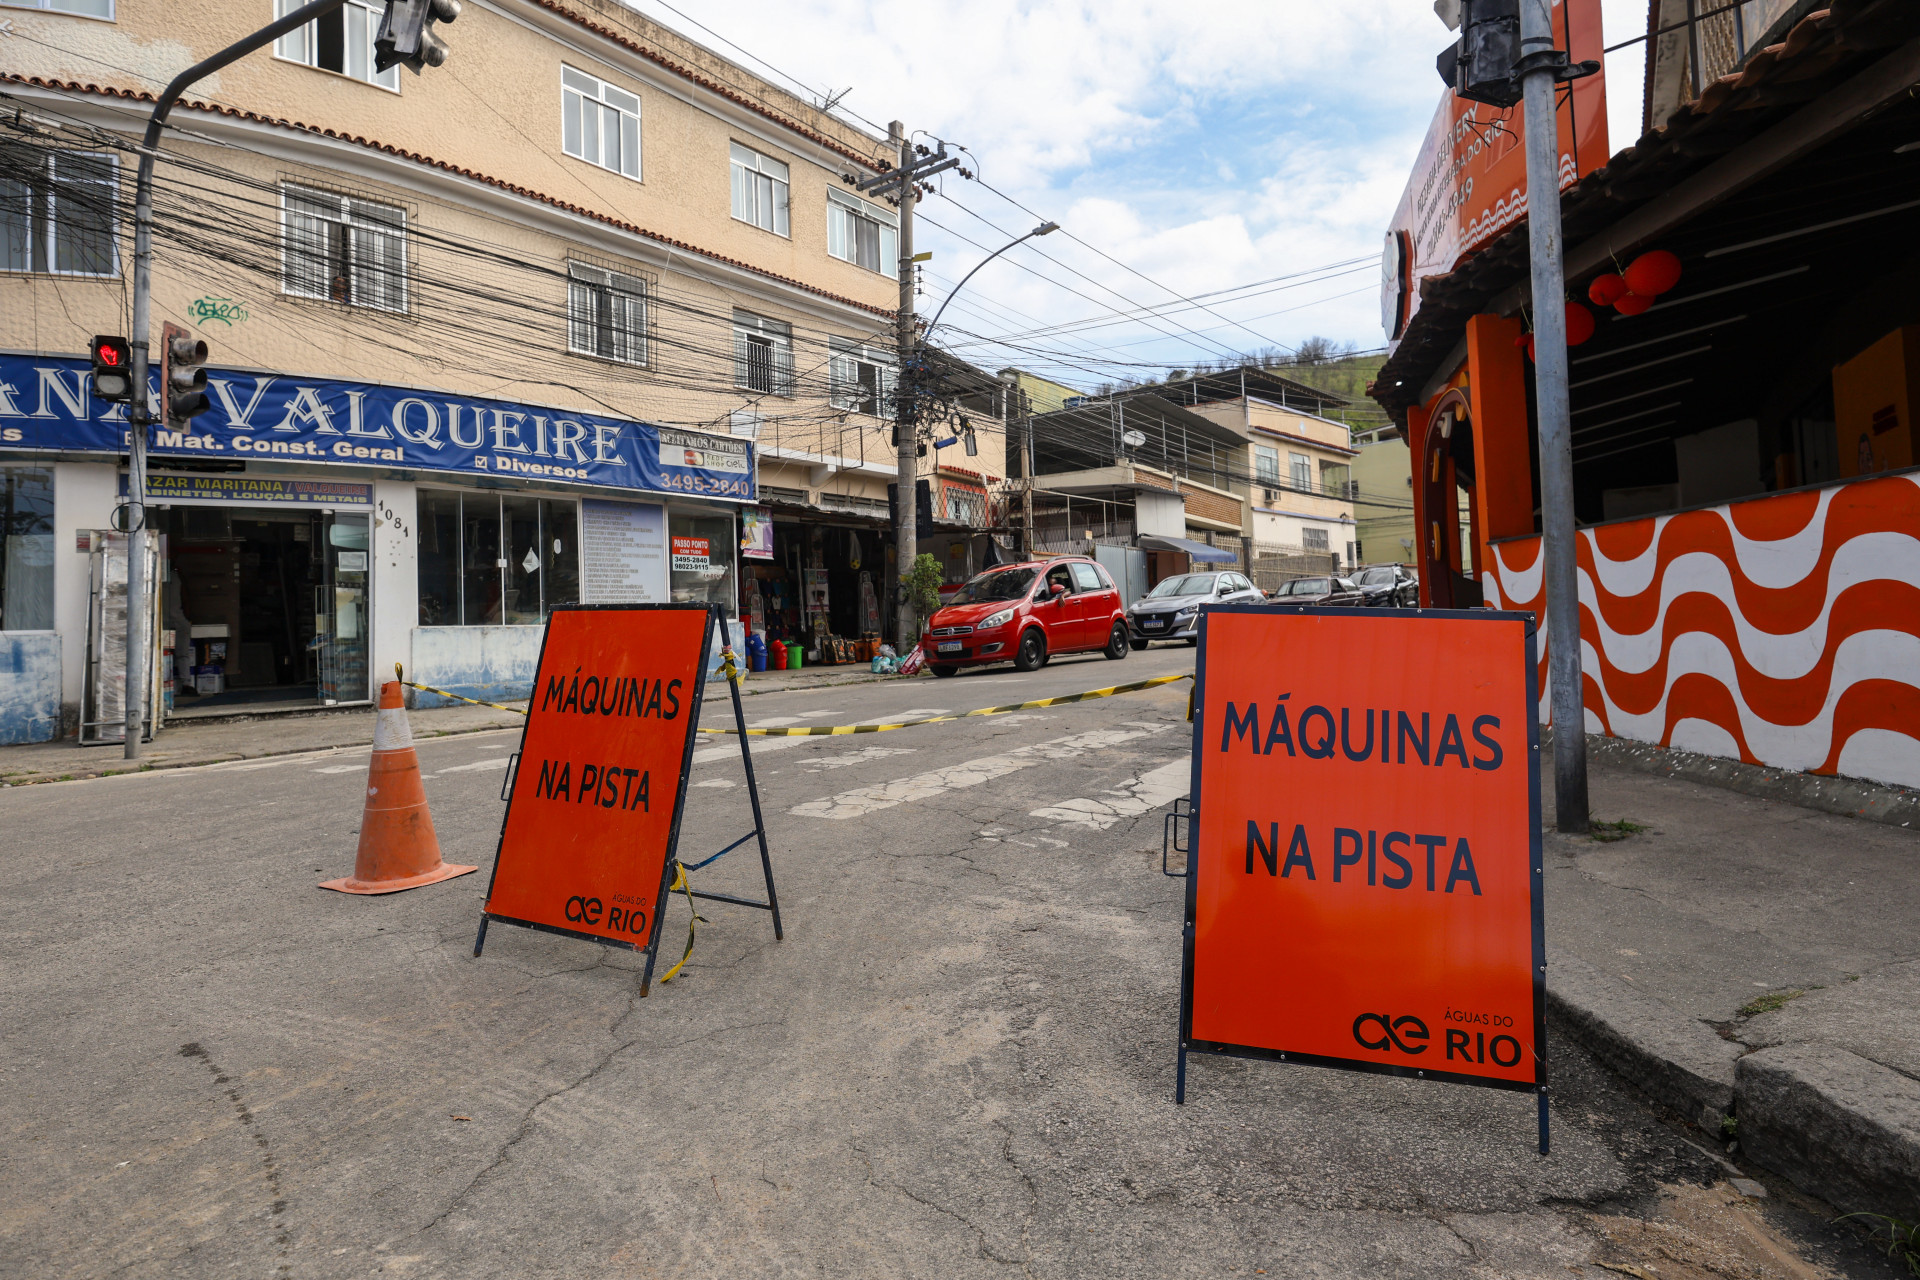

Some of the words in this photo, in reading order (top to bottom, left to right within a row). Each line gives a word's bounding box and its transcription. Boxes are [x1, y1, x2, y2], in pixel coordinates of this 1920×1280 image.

[1437, 101, 1479, 173] DELIVERY
[1467, 138, 1482, 162] DO
[1484, 120, 1504, 147] RIO
[207, 375, 627, 466] VALQUEIRE
[157, 432, 223, 450] Mat.
[232, 435, 326, 456] Const.
[333, 440, 403, 462] Geral
[661, 433, 708, 449] ACEITAMOS
[709, 439, 744, 454] CARTÕES
[496, 456, 588, 479] Diversos
[128, 476, 188, 489] AZAR
[195, 477, 283, 492] MARITANA
[294, 482, 367, 496] VALQUEIRE
[232, 491, 294, 502] LOUÇAS
[299, 492, 309, 502] E
[313, 494, 368, 504] METAIS
[660, 472, 749, 496] 3495-2840
[674, 538, 691, 548] PASSO
[691, 540, 709, 549] PONTO
[541, 666, 682, 720] MÁQUINAS
[1220, 692, 1504, 771] MÁQUINAS
[536, 760, 571, 802] NA
[578, 764, 649, 812] PISTA
[1245, 820, 1316, 881] NA
[1332, 827, 1483, 896] PISTA
[636, 896, 647, 907] DO
[608, 907, 646, 935] RIO
[1444, 1007, 1489, 1027] ÁGUAS
[1493, 1013, 1514, 1028] DO
[1446, 1030, 1522, 1067] RIO
